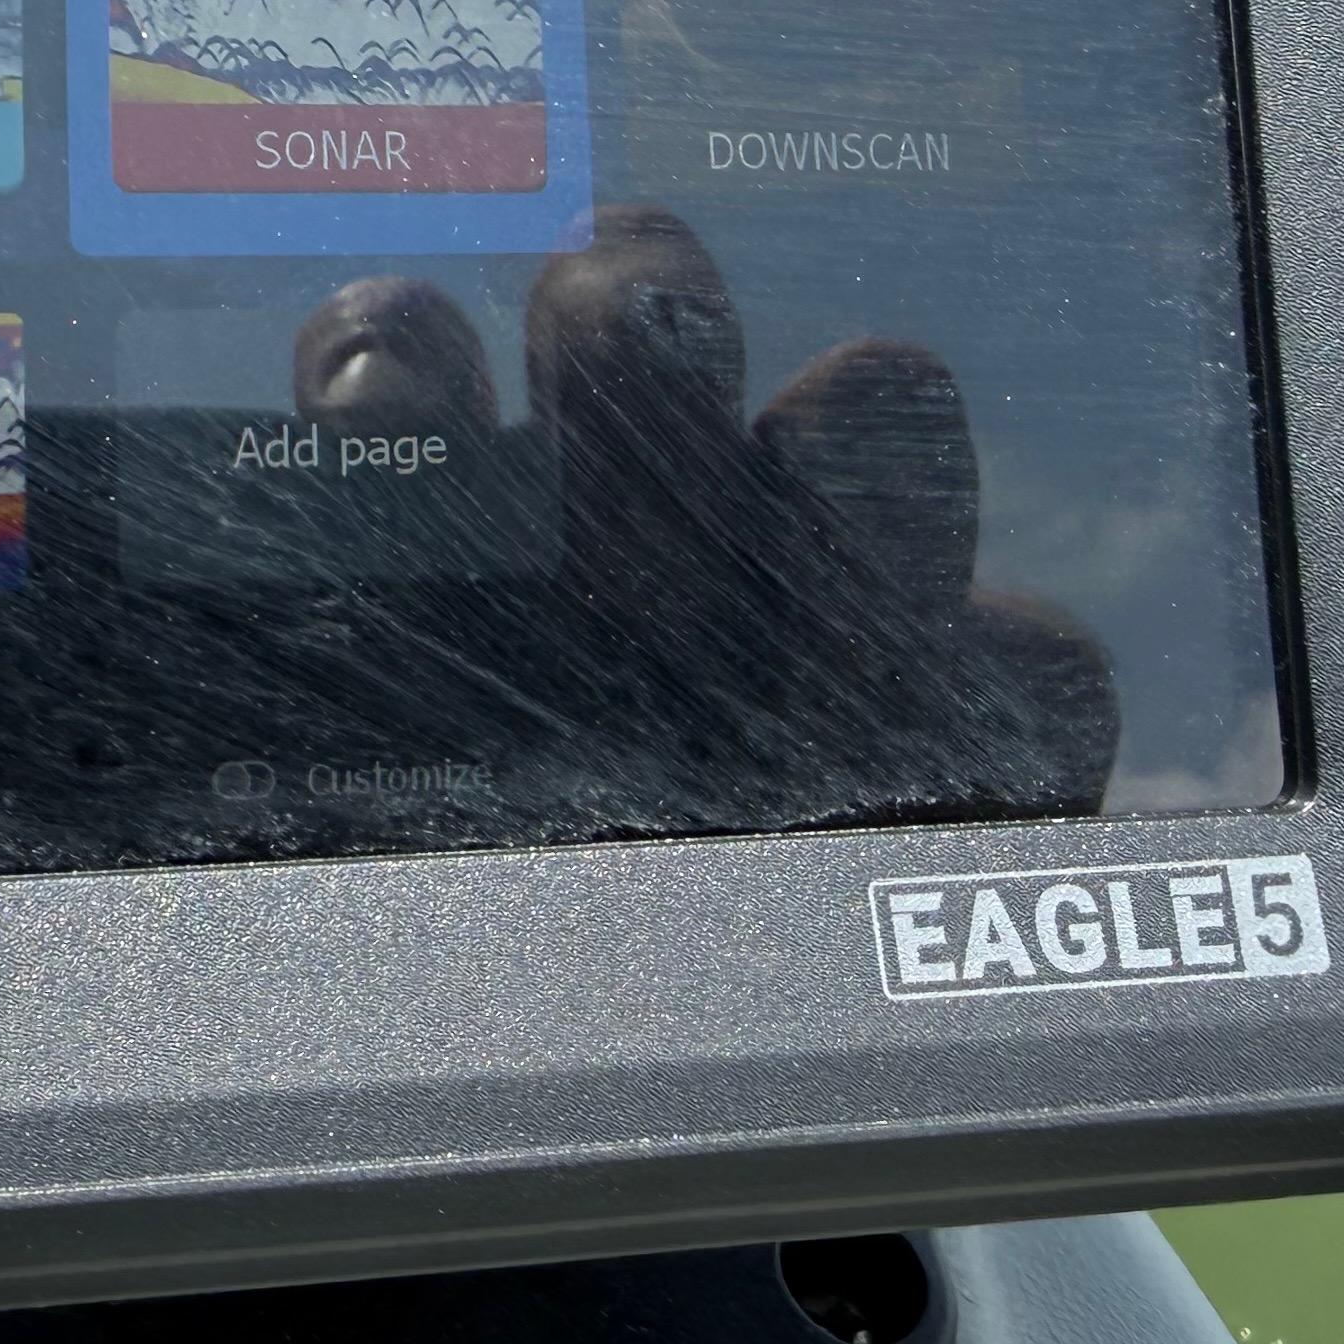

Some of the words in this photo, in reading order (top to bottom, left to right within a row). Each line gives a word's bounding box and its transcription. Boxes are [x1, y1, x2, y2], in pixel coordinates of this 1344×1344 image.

[253, 129, 411, 173] SONAR
[707, 131, 952, 173] DOWNSCAN
[232, 423, 320, 470] Add
[339, 432, 449, 478] page
[307, 759, 493, 798] Customize
